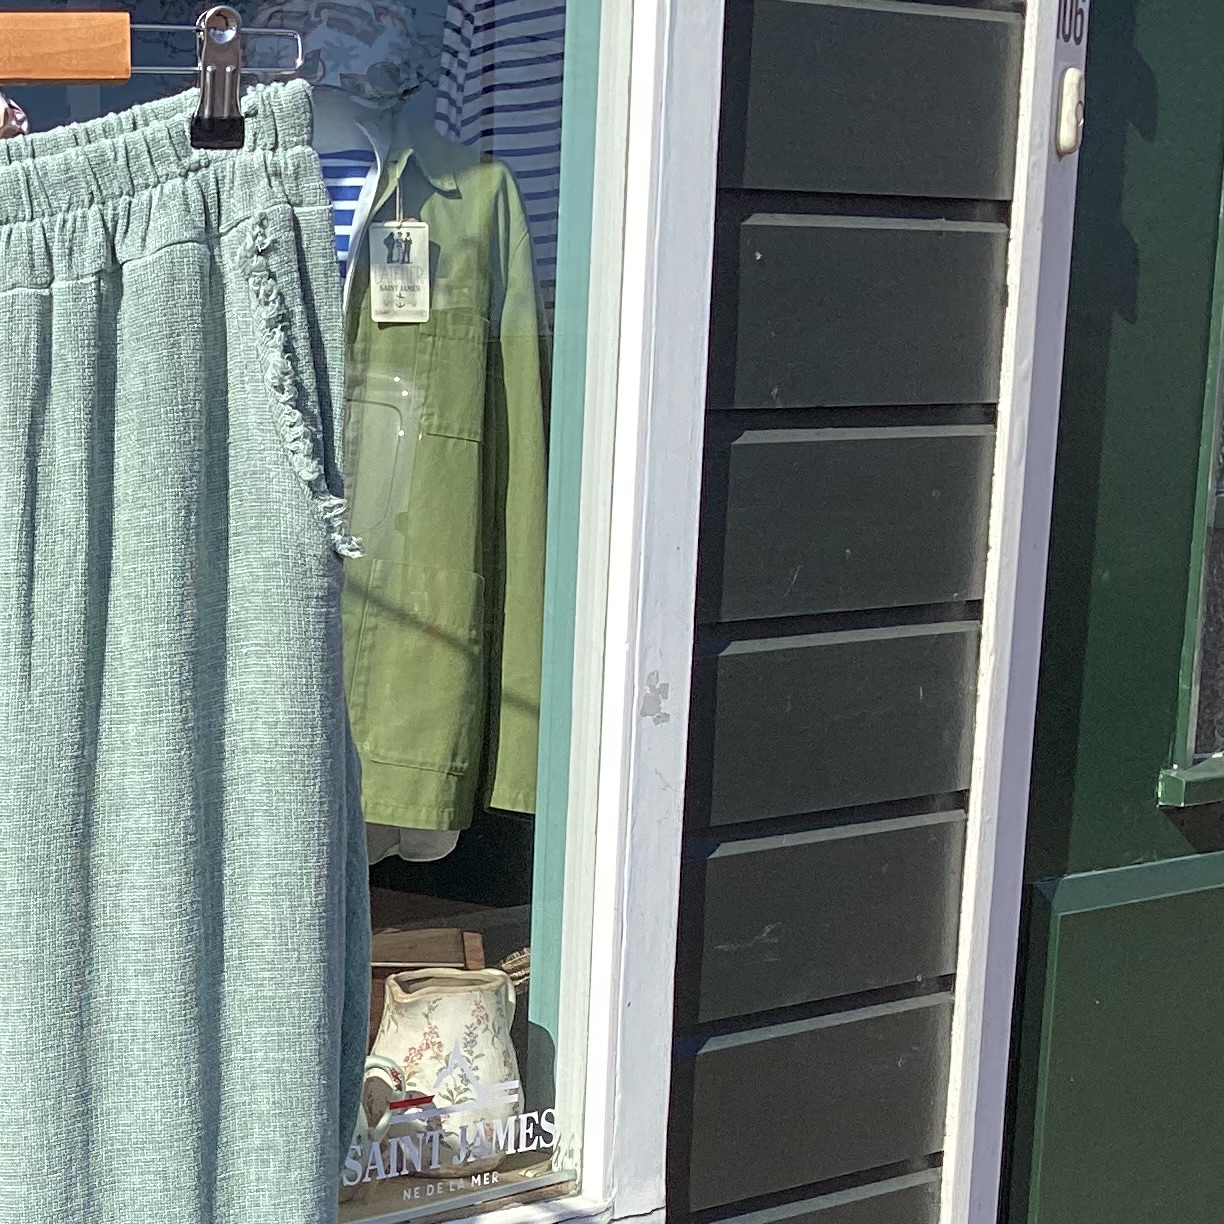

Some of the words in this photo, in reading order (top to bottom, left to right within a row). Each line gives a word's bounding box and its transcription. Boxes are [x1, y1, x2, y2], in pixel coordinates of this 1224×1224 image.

[342, 1129, 445, 1187] SAINT
[451, 1108, 556, 1166] JAMES
[426, 1183, 444, 1197] DE
[470, 1171, 499, 1188] MER
